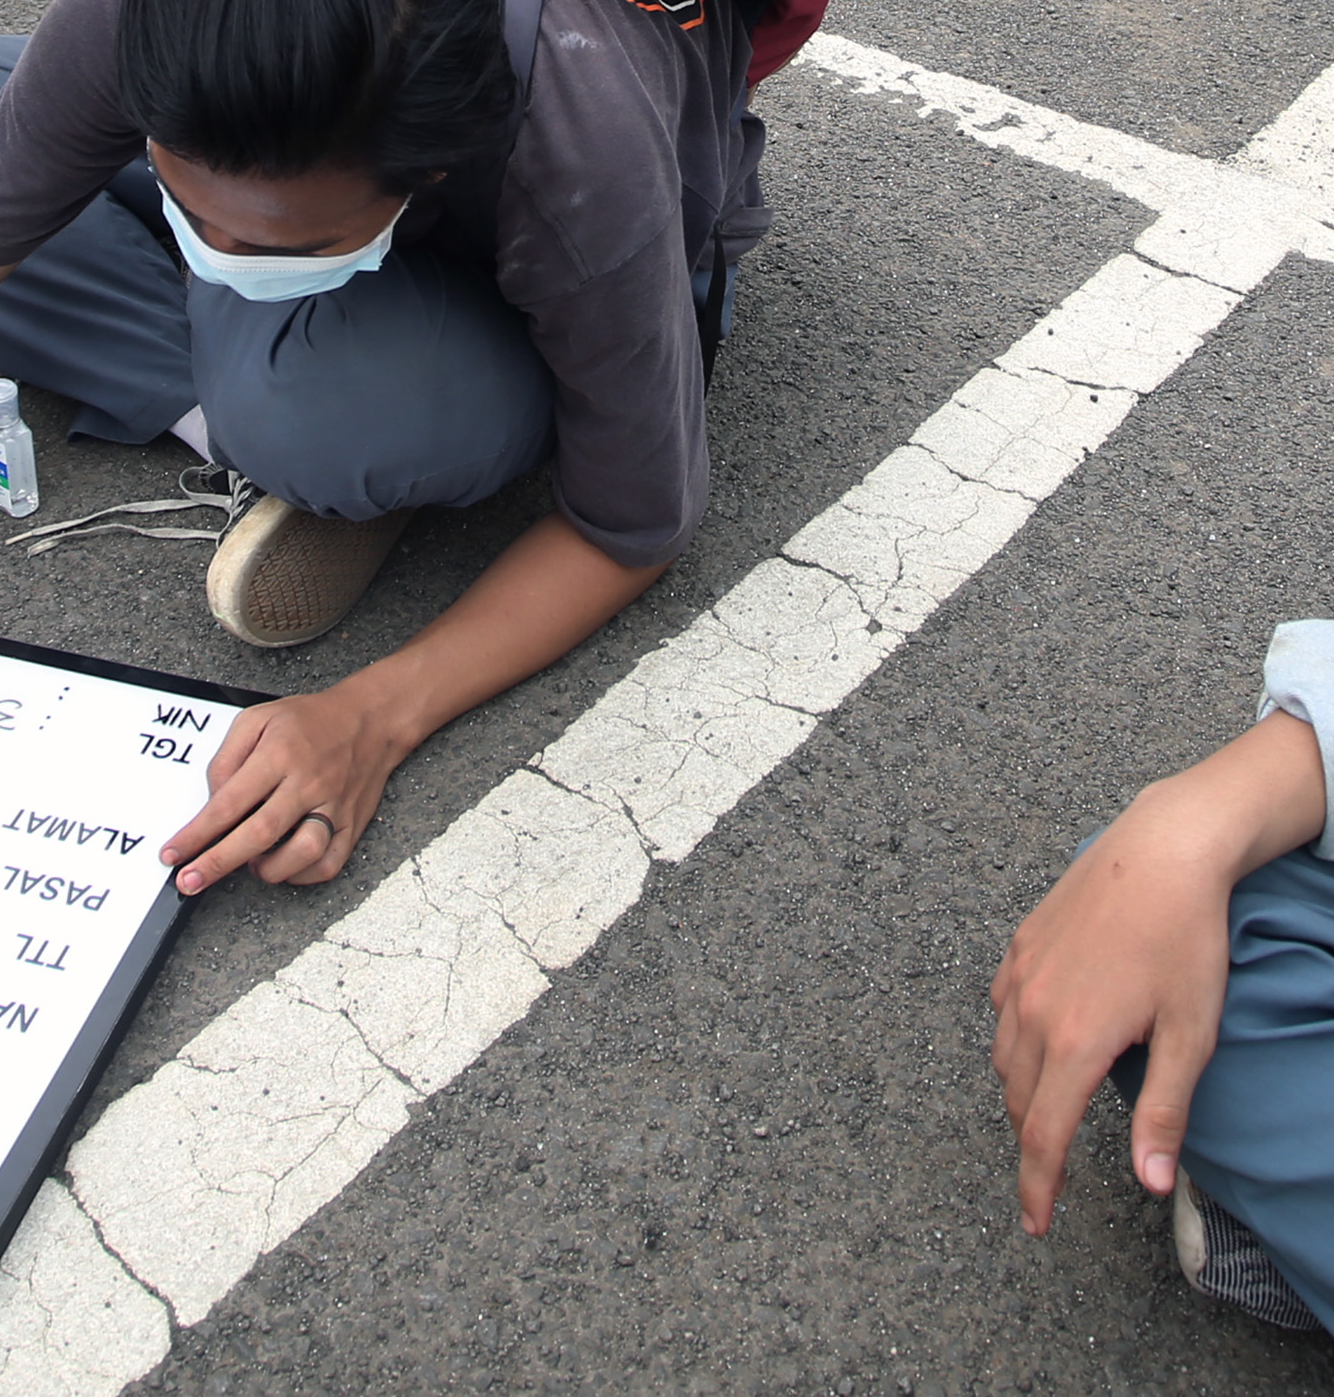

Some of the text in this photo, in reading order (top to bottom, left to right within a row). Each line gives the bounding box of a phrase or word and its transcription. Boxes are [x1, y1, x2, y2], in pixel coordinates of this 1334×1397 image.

[152, 704, 211, 733] NIK
[138, 733, 194, 765] TGL
[1, 808, 145, 856] ALAMAT
[3, 865, 111, 912] PASAL
[15, 933, 71, 972] TTL
